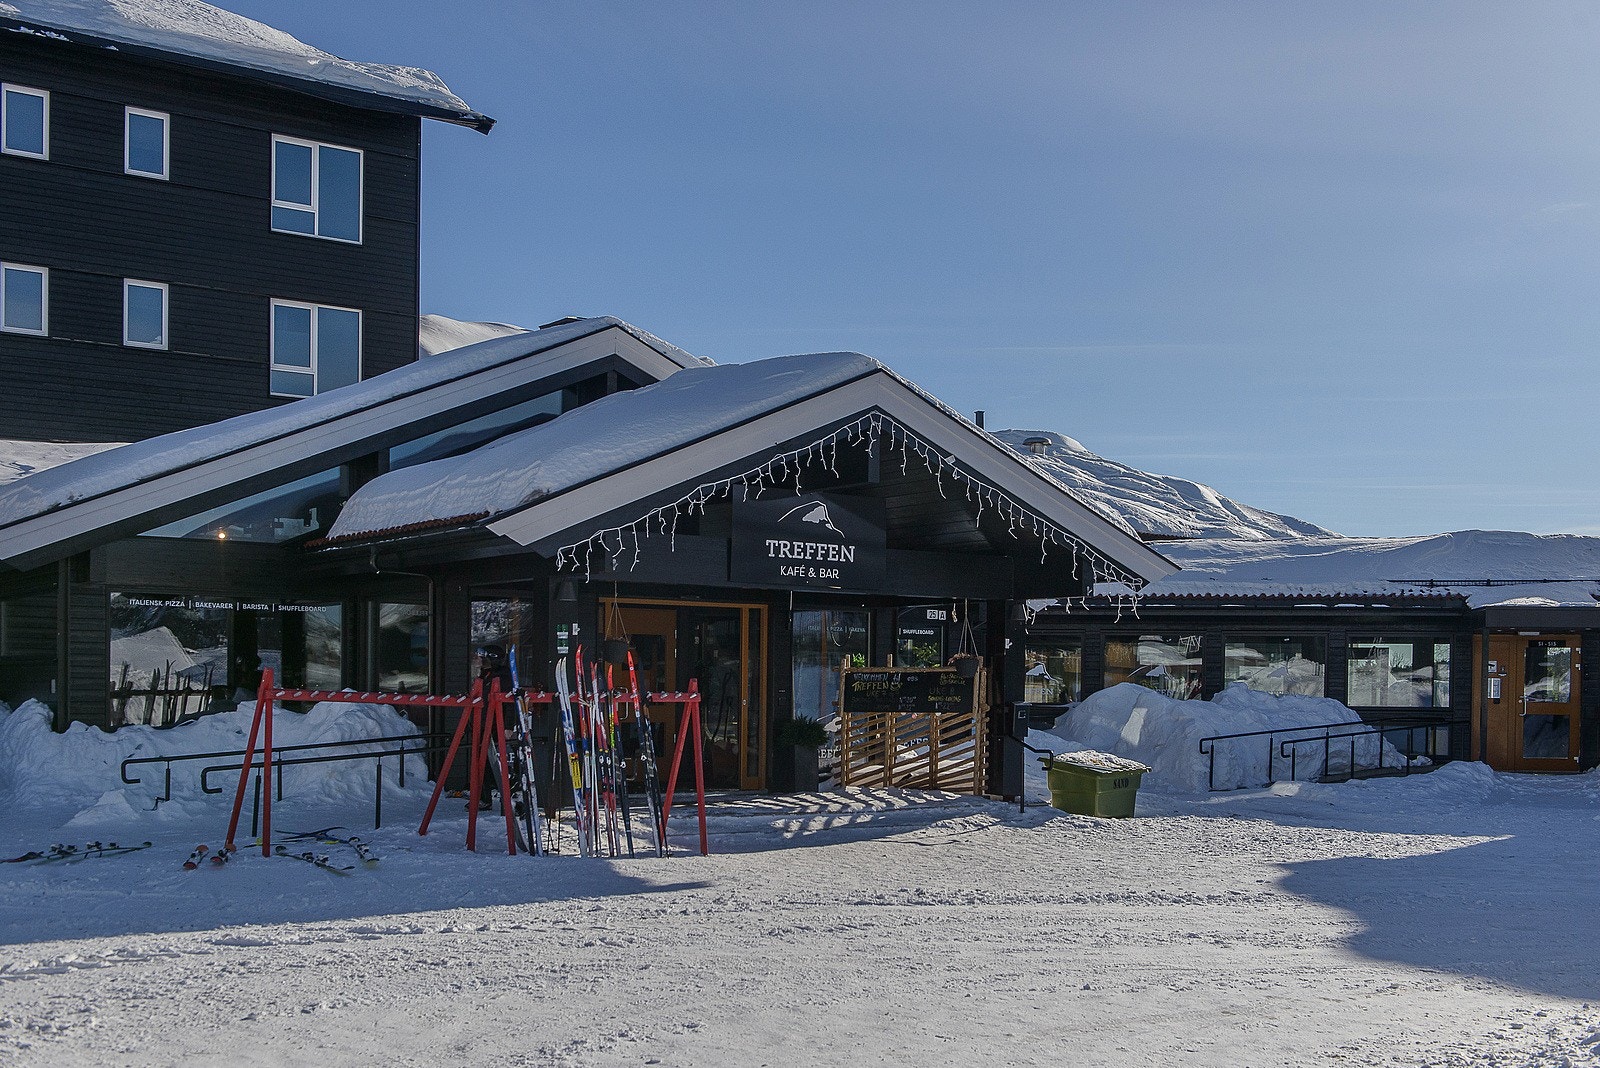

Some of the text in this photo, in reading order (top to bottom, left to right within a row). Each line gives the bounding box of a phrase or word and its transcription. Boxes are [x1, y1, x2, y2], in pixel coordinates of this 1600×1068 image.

[765, 539, 856, 563] TREFFEN
[780, 564, 840, 579] KAFÉ & BAR
[129, 599, 163, 607] ITALIENSK
[278, 605, 327, 613] SHUFFLEBOARD
[929, 610, 945, 619] 25 A
[852, 681, 889, 692] TREFFEN
